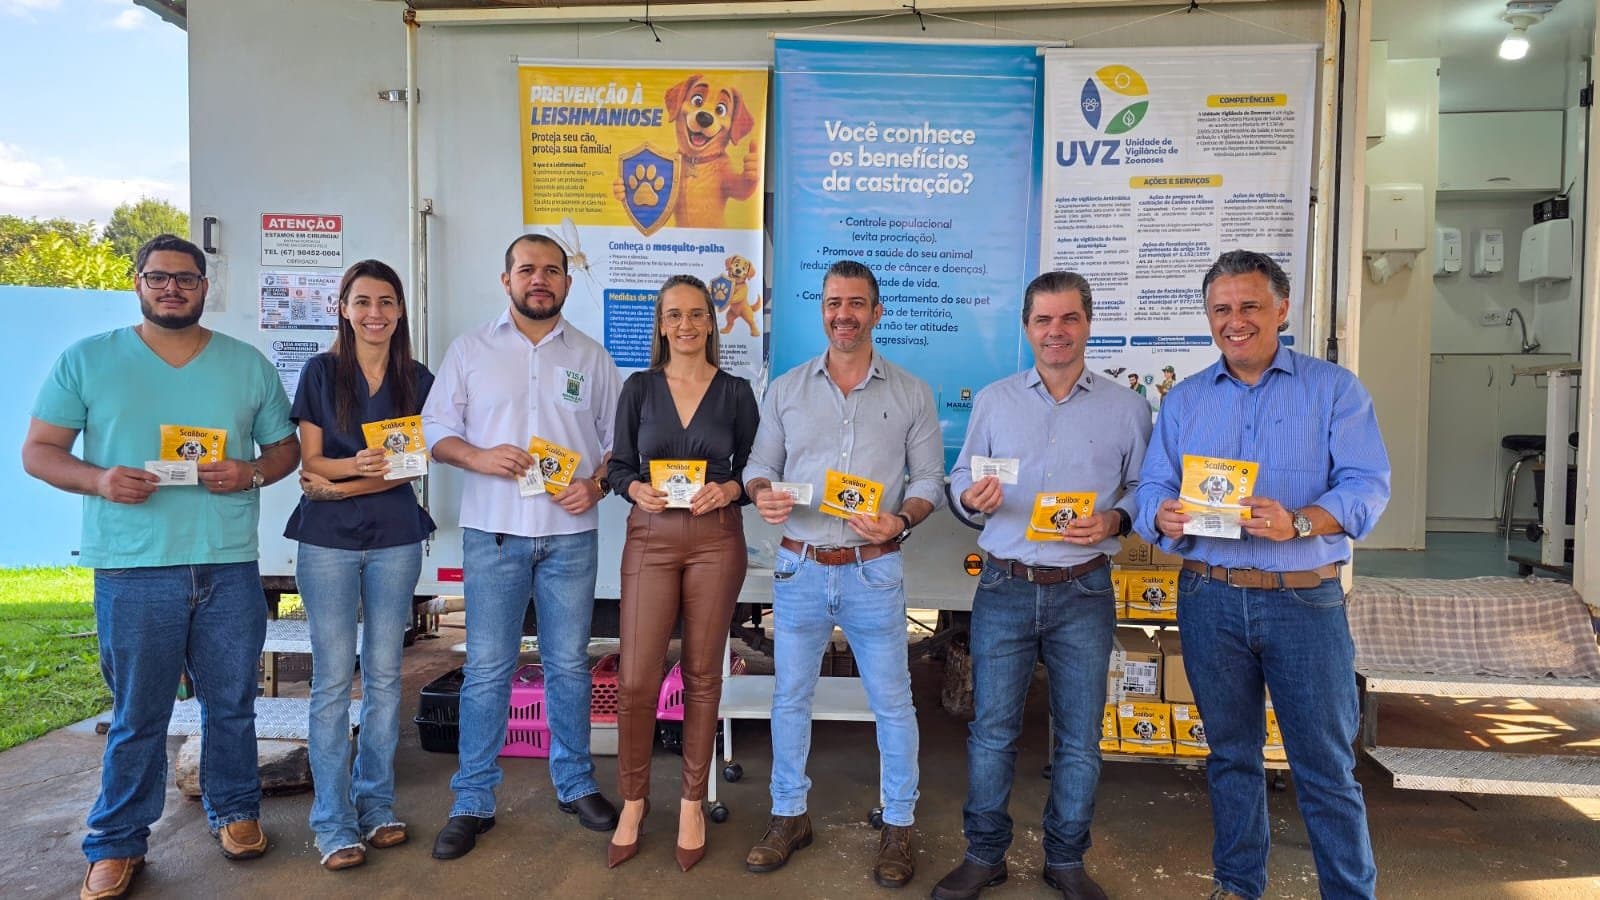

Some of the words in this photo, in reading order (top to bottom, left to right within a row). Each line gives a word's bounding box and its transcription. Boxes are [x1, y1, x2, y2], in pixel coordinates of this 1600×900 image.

[530, 83, 628, 107] PREVENÇÃO
[630, 83, 644, 105] À
[1220, 96, 1276, 104] COMPETÊNCIAS
[531, 107, 663, 126] LEISHMANIOSE
[532, 132, 561, 145] Proteja
[563, 134, 578, 142] seu
[580, 133, 597, 144] cão,
[824, 120, 878, 143] Você
[883, 121, 976, 145] conhece
[1125, 138, 1160, 146] Unidade
[1162, 137, 1172, 146] de
[532, 144, 561, 155] proteja
[580, 144, 612, 154] família!
[1056, 140, 1120, 167] UVZ
[1125, 146, 1166, 157] Vigilância
[1168, 146, 1178, 154] de
[829, 151, 853, 167] os
[858, 145, 969, 169] benefícios
[1125, 156, 1164, 164] Zoonoses
[822, 170, 851, 192] da
[855, 172, 974, 198] castração?
[1144, 176, 1167, 186] AÇÕES
[1174, 176, 1210, 186] SERVIÇOS
[269, 217, 336, 231] ATENÇÃO
[846, 217, 886, 227] Controle
[889, 219, 952, 230] populacional
[852, 232, 878, 243] (evita
[880, 233, 937, 244] procriação).
[609, 241, 643, 253] Conheça
[653, 242, 725, 254] mosquito-palha
[822, 247, 864, 257] Promove
[875, 248, 904, 257] saúde
[906, 249, 919, 258] do
[939, 250, 973, 259] animal
[884, 263, 897, 271] de
[898, 263, 931, 272] câncer
[942, 264, 988, 275] doenças).
[902, 279, 914, 287] de
[916, 279, 940, 288] vida.
[879, 295, 938, 306] portamento
[940, 296, 953, 304] do
[974, 296, 990, 306] pet
[896, 308, 908, 317] de
[910, 308, 953, 319] território,
[884, 321, 902, 331] não
[904, 322, 917, 331] ter
[920, 323, 958, 332] atitudes
[876, 336, 928, 346] agressivas).
[566, 370, 584, 382] VISA
[180, 428, 208, 438] Scalibor
[1204, 460, 1236, 472] Scalibor
[841, 476, 867, 489] Scalibor
[1056, 496, 1080, 504] Scalibor
